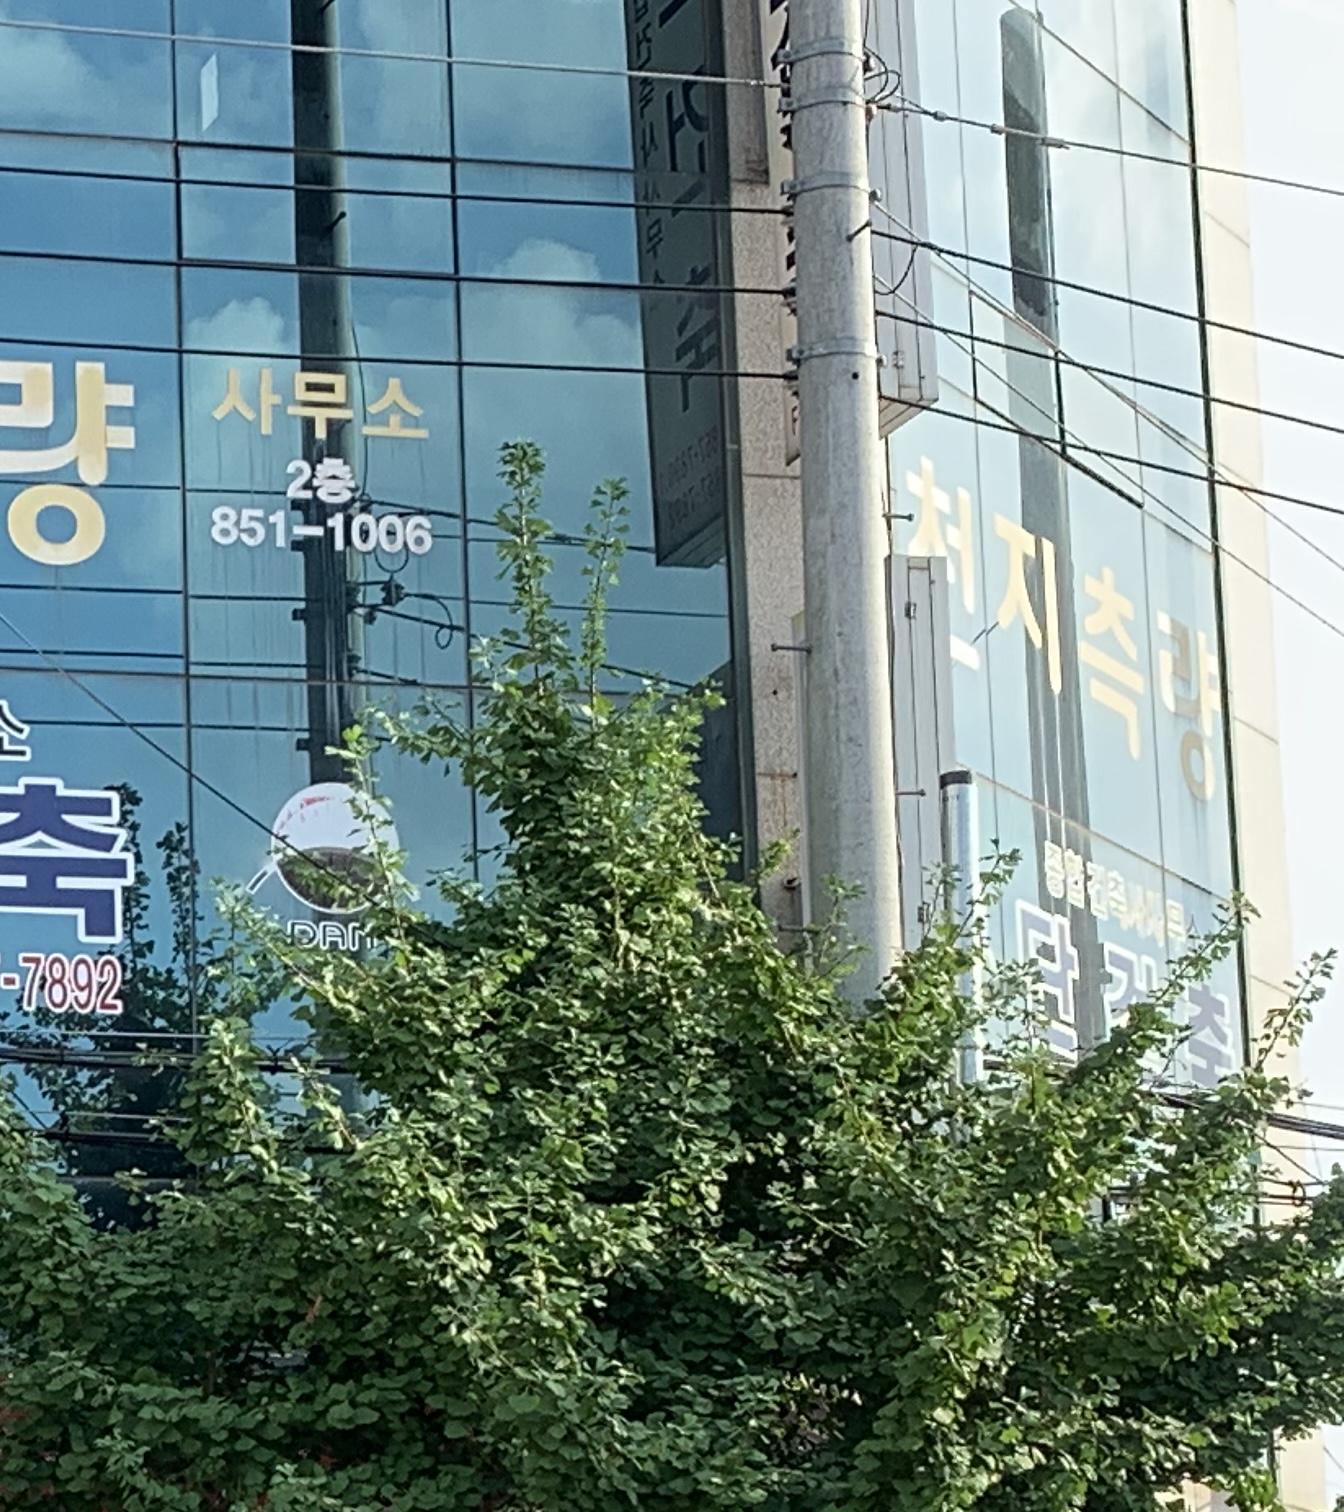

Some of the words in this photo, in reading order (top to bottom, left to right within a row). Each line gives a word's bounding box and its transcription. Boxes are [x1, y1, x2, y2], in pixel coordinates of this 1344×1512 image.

[211, 367, 430, 440] 사무소
[285, 457, 356, 504] 2층
[210, 505, 434, 555] 851-1006
